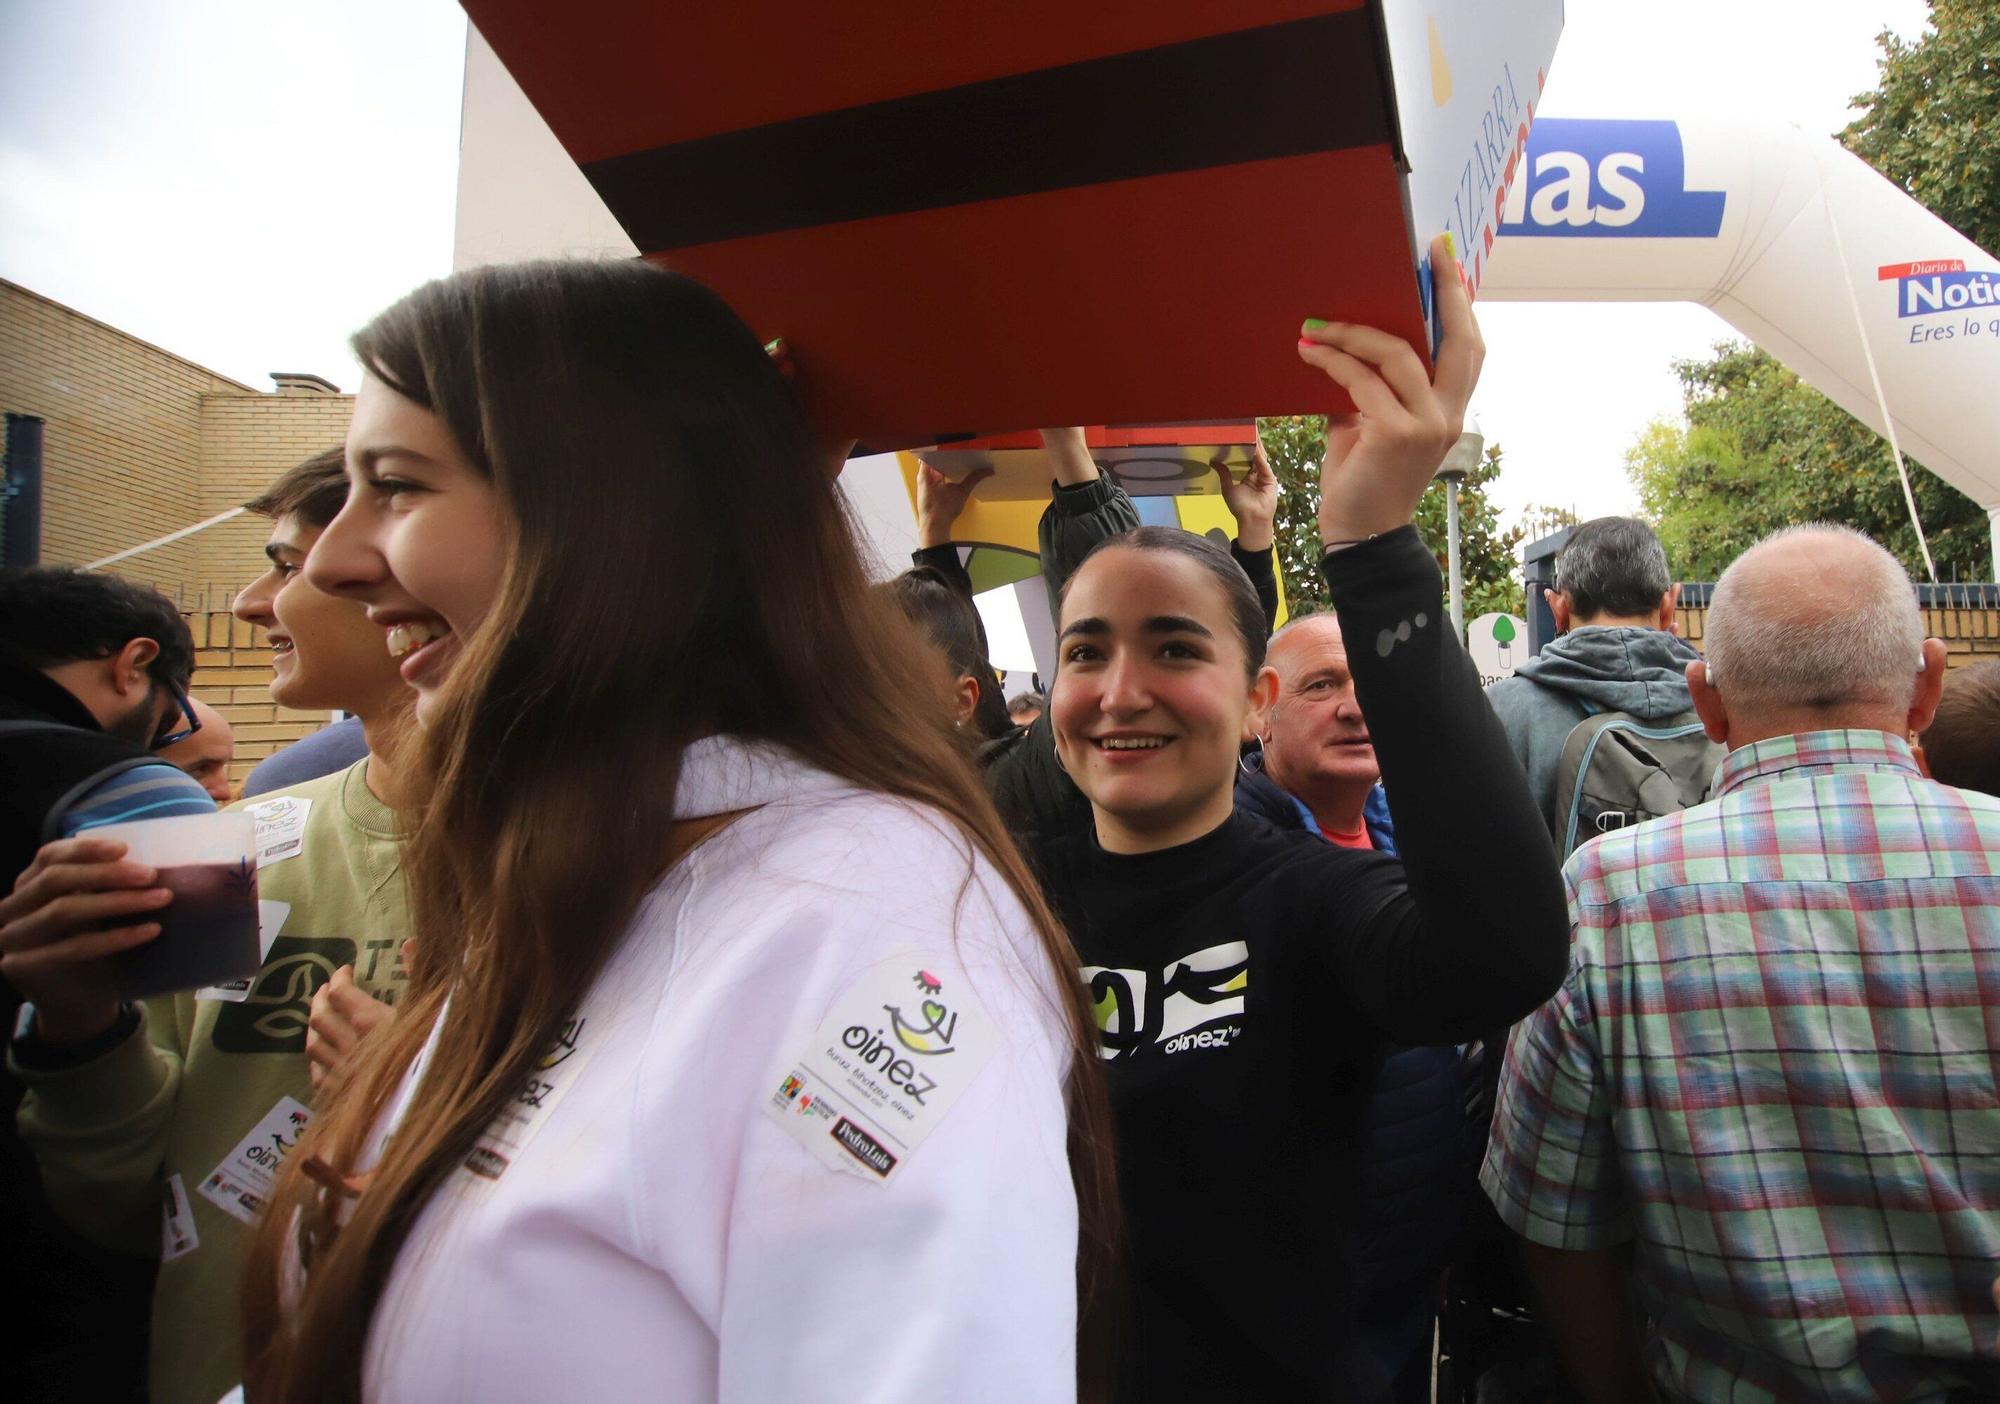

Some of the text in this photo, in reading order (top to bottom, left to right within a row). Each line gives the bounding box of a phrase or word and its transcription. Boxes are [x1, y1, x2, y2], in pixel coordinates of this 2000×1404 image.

[1446, 62, 1519, 267] IZARRA
[1910, 259, 1962, 275] Diario de
[1910, 323, 1955, 344] Eres
[1963, 317, 1980, 336] lo
[842, 1026, 937, 1106] oinez
